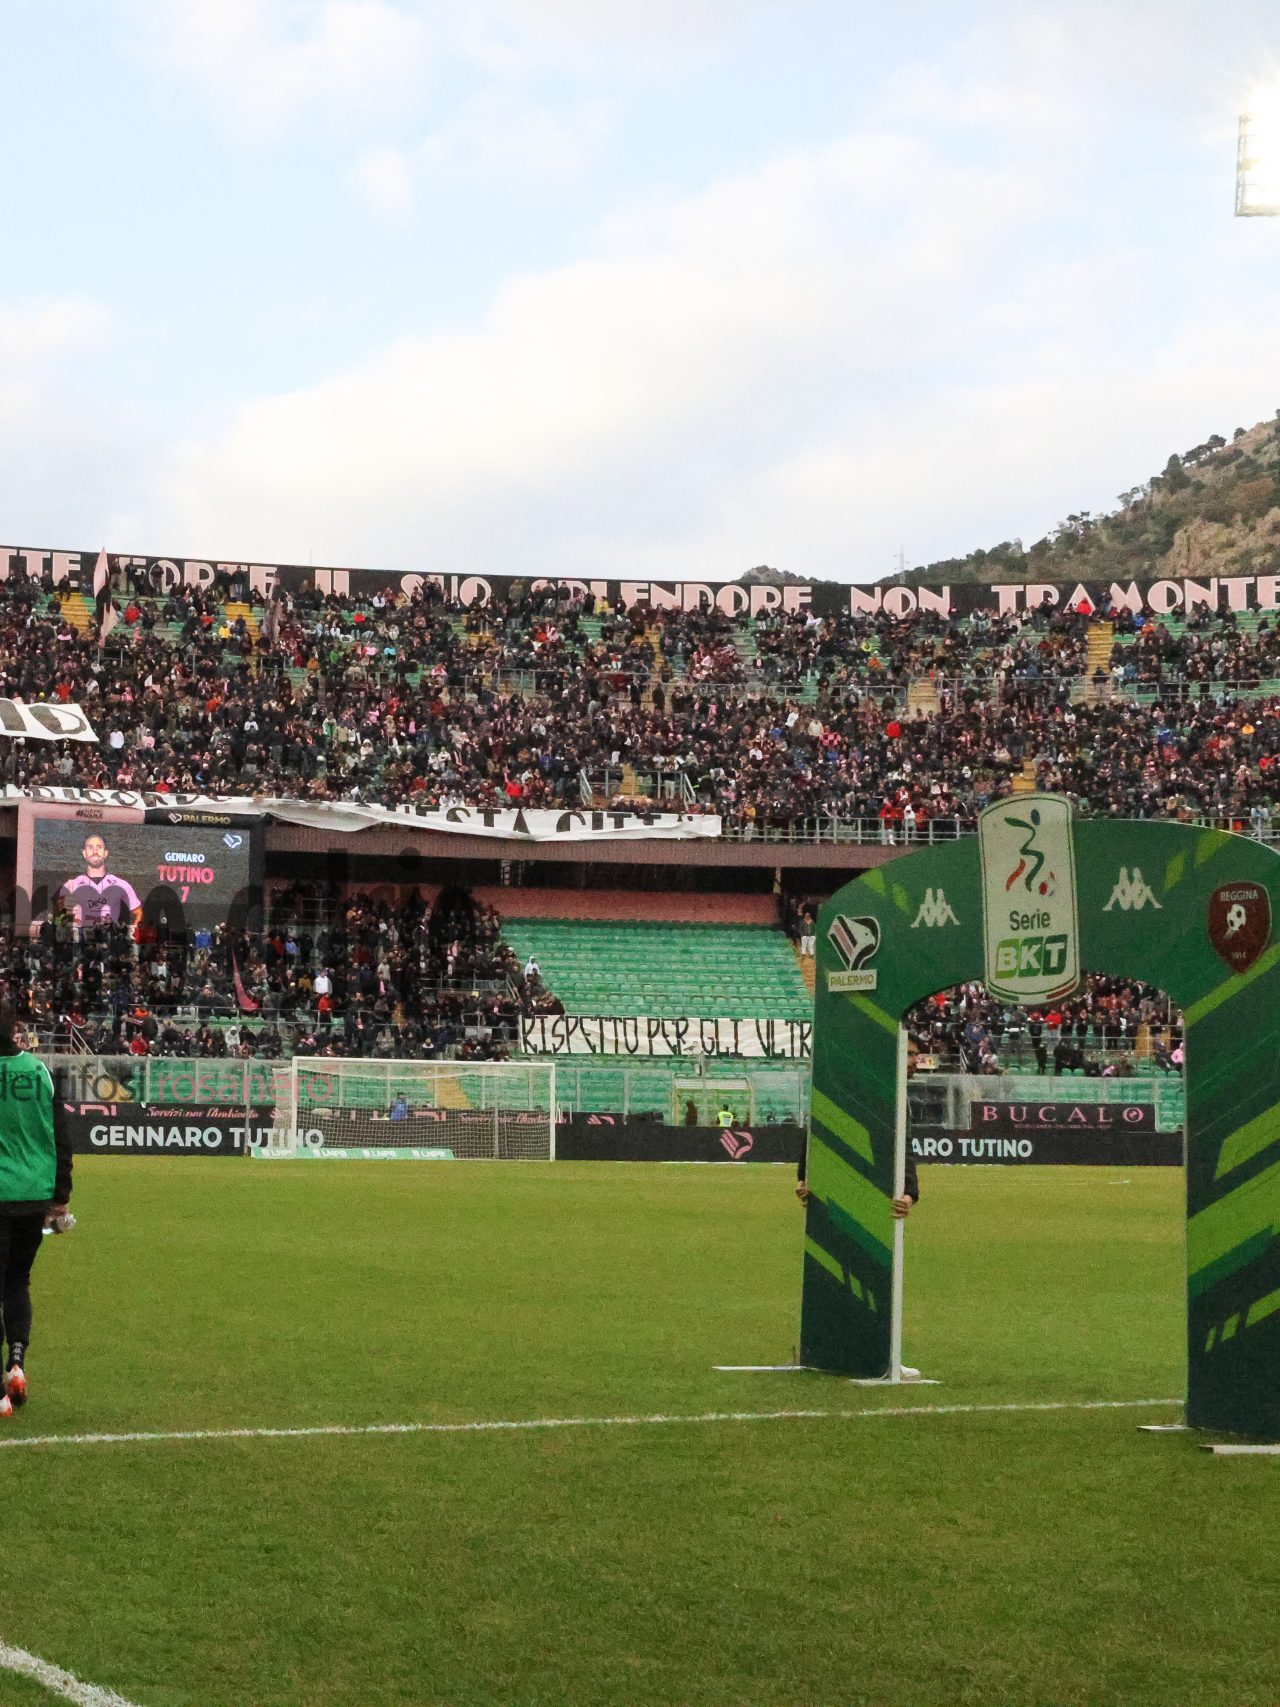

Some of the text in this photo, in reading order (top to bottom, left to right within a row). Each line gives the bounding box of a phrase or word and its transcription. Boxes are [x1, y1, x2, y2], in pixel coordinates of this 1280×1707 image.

[850, 585, 951, 620] NON
[183, 813, 231, 826] PALERMO
[165, 852, 205, 864] GENNARO
[156, 865, 215, 884] TUTINO
[1220, 889, 1259, 902] REGGINA
[1009, 909, 1051, 931] Serie
[996, 939, 1066, 974] BKT
[830, 974, 874, 987] PALERMO
[89, 1125, 222, 1147] GENNARO
[957, 1138, 1033, 1158] TUTINO
